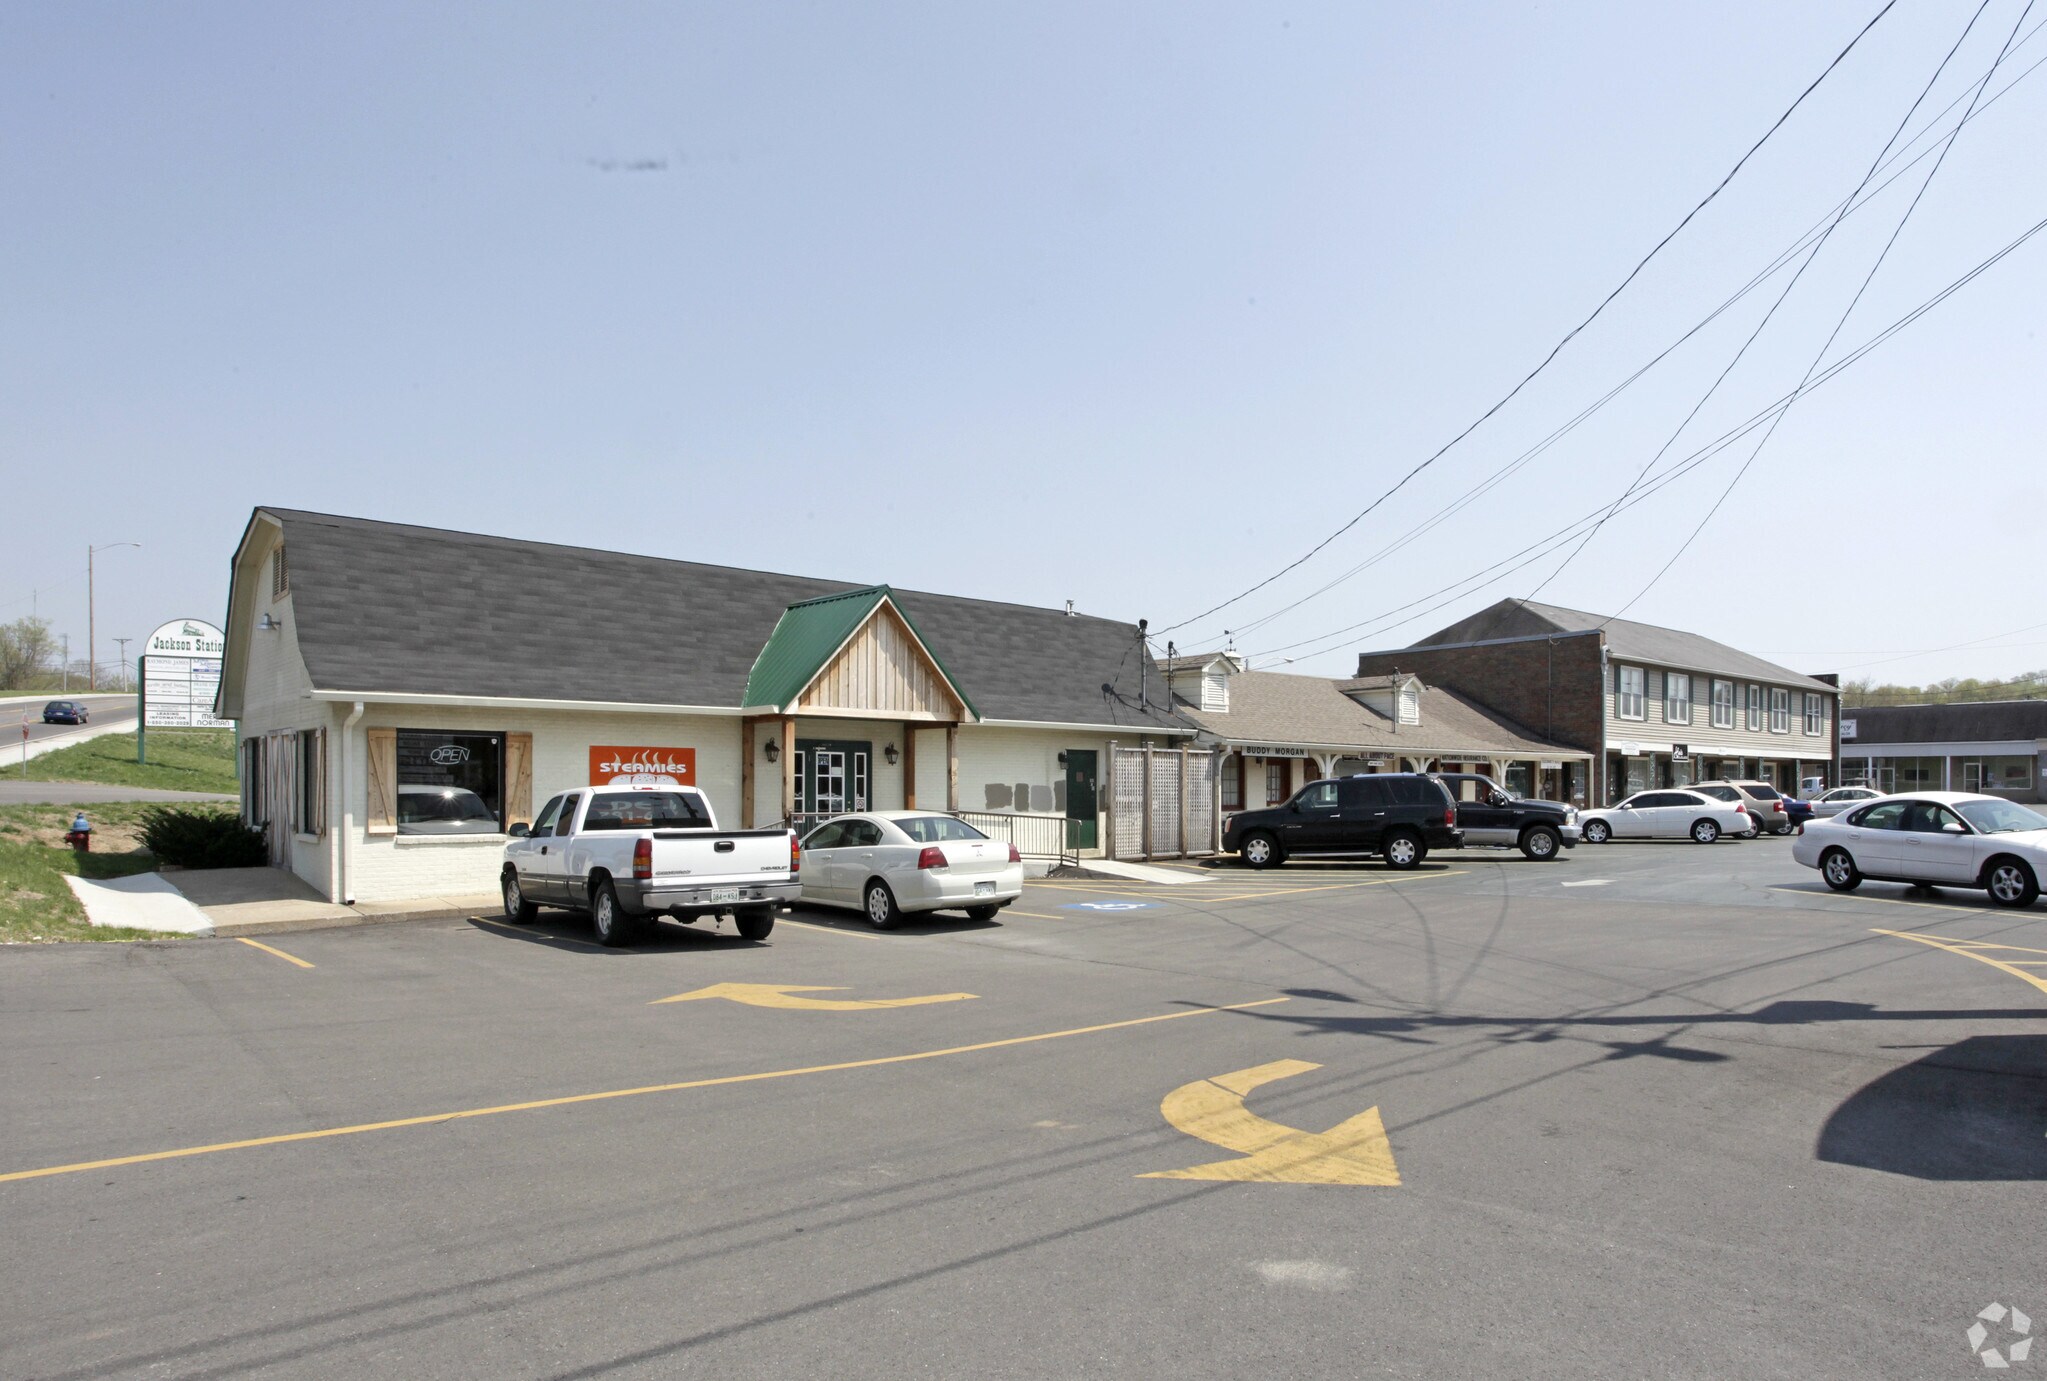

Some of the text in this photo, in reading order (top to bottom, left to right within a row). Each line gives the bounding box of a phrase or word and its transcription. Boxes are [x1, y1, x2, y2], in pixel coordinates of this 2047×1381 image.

[154, 637, 224, 652] Jackson Statio
[430, 749, 470, 761] OPEN
[1246, 746, 1271, 754] BUDDY
[600, 762, 687, 773] STEAMIES
